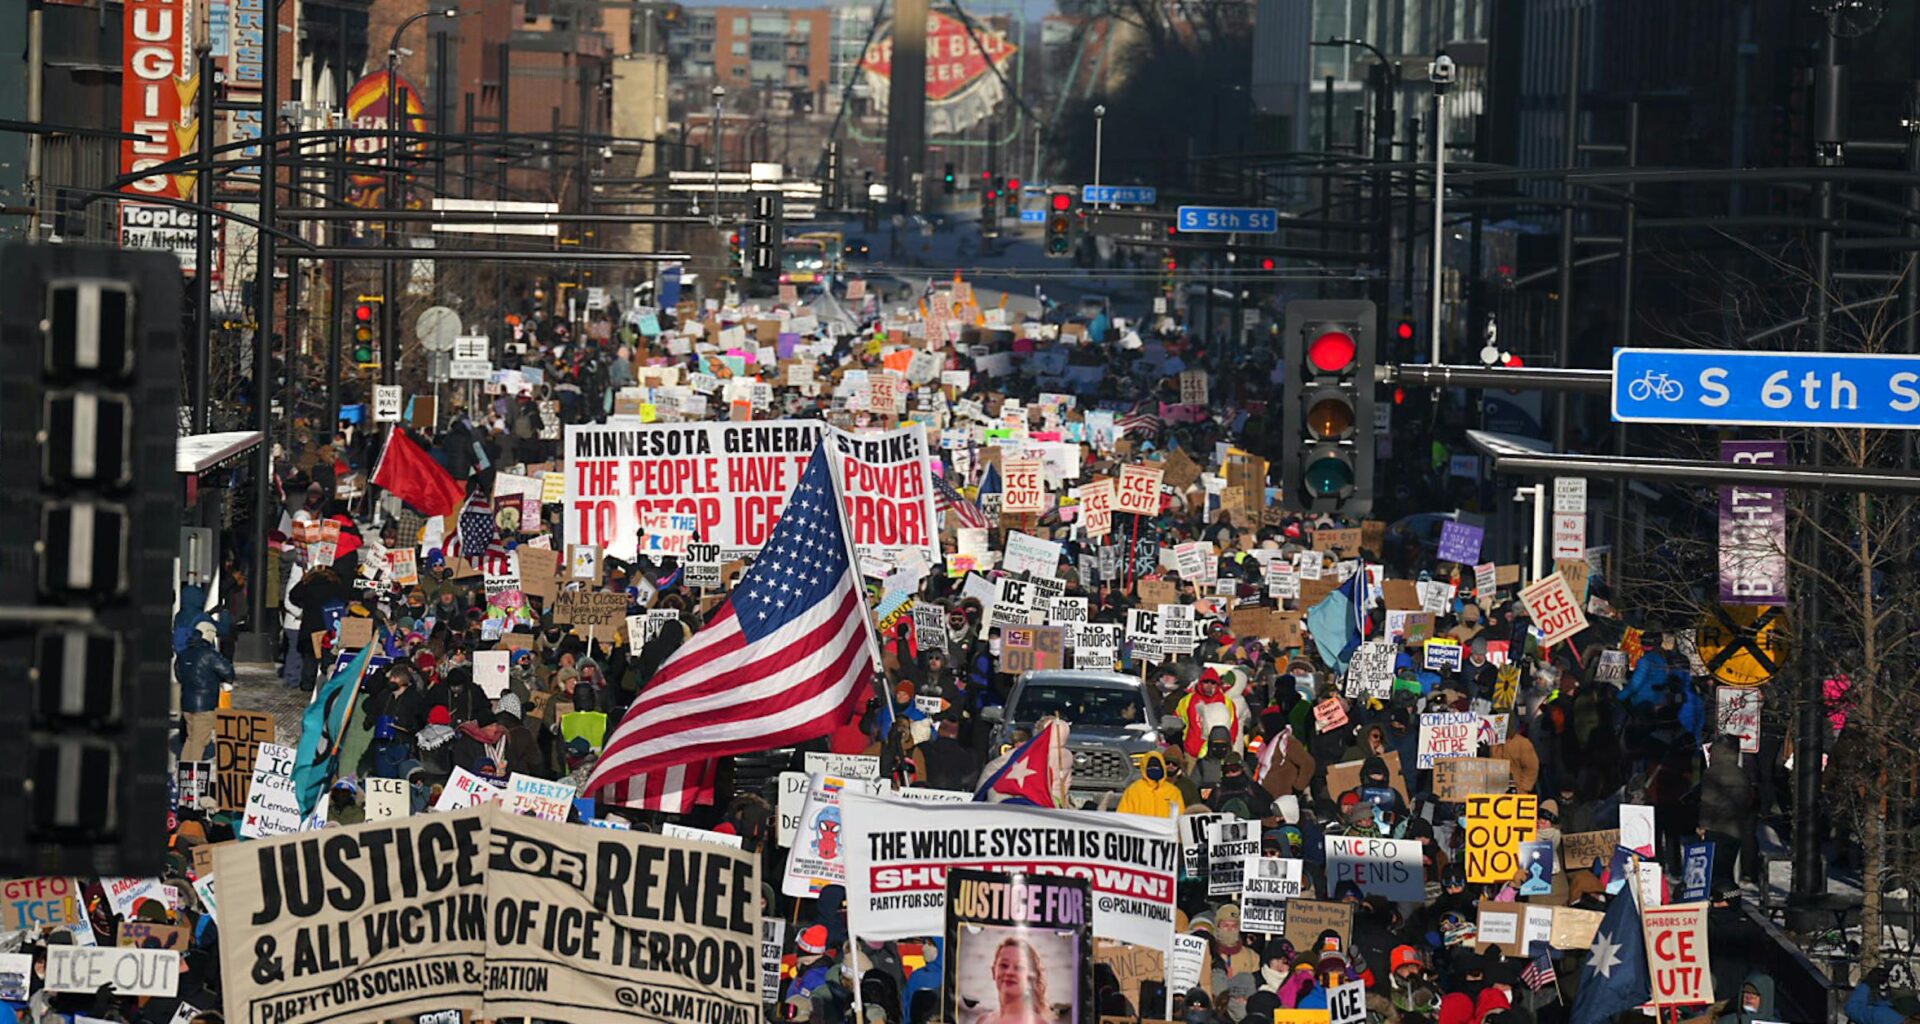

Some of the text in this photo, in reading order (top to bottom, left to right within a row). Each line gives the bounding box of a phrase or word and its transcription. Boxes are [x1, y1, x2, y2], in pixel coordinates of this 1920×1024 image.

[131, 0, 175, 199] UGIES
[123, 208, 218, 230] Tople
[1186, 213, 1269, 229] S 5th St
[378, 389, 398, 399] ONE
[871, 384, 893, 397] ICE
[1699, 367, 1858, 410] S 6th
[379, 399, 398, 407] WAY
[576, 428, 711, 457] MINNESOTA
[837, 433, 921, 464] STRIKE:
[576, 461, 618, 496] THE
[629, 459, 718, 496] PEOPLE
[727, 456, 787, 492] HAVE
[844, 457, 924, 500] POWER
[1006, 474, 1037, 489] ICE
[1123, 475, 1156, 496] ICE
[1006, 490, 1040, 506] OUT!
[1084, 494, 1110, 513] ICE
[1120, 491, 1156, 513] OUT!
[575, 500, 618, 550] TO
[735, 496, 783, 546] ICE
[844, 497, 928, 546] ROR!
[644, 516, 696, 531] WE THE
[1085, 510, 1110, 529] OUT
[1563, 520, 1576, 530] NO
[1556, 532, 1583, 543] STOPPING
[687, 545, 719, 563] STOP
[686, 574, 719, 582] NOW!
[697, 566, 719, 574] TERROR
[1002, 581, 1027, 605] ICE
[1030, 576, 1064, 592] GENERAL
[580, 592, 592, 606] IS
[592, 592, 627, 606] CLOSED
[1058, 599, 1080, 608] NO
[1531, 589, 1570, 619] ICE
[893, 600, 913, 619] OUT
[991, 611, 1029, 625] MINNESOTA
[993, 604, 1030, 615] OUT OF
[1051, 606, 1087, 622] TROOPS
[587, 613, 613, 626] OUT
[915, 611, 944, 629] STRIKE
[1135, 611, 1159, 635] ICE
[1541, 609, 1578, 637] OUT!
[1008, 630, 1030, 642] ICE
[1083, 625, 1104, 634] NO
[1076, 633, 1112, 648] TROOPS
[1076, 656, 1111, 667] MINNESOTA
[1428, 647, 1459, 659] DEPORT
[1370, 680, 1380, 690] TO
[1729, 696, 1746, 709] NO
[1420, 712, 1477, 727] COMPLEXION
[217, 715, 267, 743] ICE
[1431, 724, 1468, 739] SHOULD
[262, 744, 289, 759] USES
[1427, 738, 1467, 753] NOT BE
[217, 742, 259, 775] DEE
[265, 776, 297, 795] Coff
[373, 779, 403, 795] ICE
[515, 779, 574, 799] LIBERTY
[260, 794, 301, 816] Lemona
[378, 802, 392, 817] is
[513, 795, 567, 817] JUSTICE
[1467, 796, 1537, 821] ICE
[260, 814, 301, 833] Nationa
[1189, 815, 1223, 845] IC
[1467, 826, 1534, 849] OUT
[1565, 837, 1595, 849] SHOW
[868, 831, 908, 861] THE
[911, 828, 988, 859] WHOLE
[990, 826, 1075, 858] SYSTEM
[1079, 828, 1100, 858] IS
[1104, 833, 1178, 872] GUILTY!
[1210, 842, 1243, 858] JUSTICE
[1243, 841, 1260, 855] FOR
[1333, 840, 1398, 858] MICRO
[1211, 860, 1245, 871] REN
[1337, 860, 1409, 885] PENIS
[251, 817, 485, 926] JUSTICE
[593, 841, 754, 936] RENEE
[1035, 865, 1168, 899] WN!
[1210, 870, 1240, 885] NICOLE
[4, 876, 68, 900] GTFO
[1245, 879, 1300, 896] JUSTICE FOR
[869, 895, 901, 913] PARTY
[902, 894, 923, 909] FOR
[1098, 896, 1173, 923] @PSLNATIONAL
[953, 878, 1086, 925] JUSTICE FOR
[11, 895, 73, 930] ICE!
[1243, 907, 1273, 922] NICOLE
[122, 924, 152, 938] ICE
[1646, 916, 1699, 929] GHBORS SAY
[250, 893, 756, 994] & ALL VICTIM OF ICE TERROR!
[1183, 938, 1204, 951] OUT
[1655, 929, 1697, 963] CE
[50, 950, 104, 990] ICE
[113, 952, 177, 991] OUT
[261, 994, 319, 1024] PARTY
[318, 978, 360, 1008] FOR
[362, 960, 460, 1001] SOCIALISM
[462, 960, 482, 984] &
[484, 965, 549, 992] RATION
[1657, 966, 1703, 1000] UT!
[1331, 986, 1362, 1021] ICE
